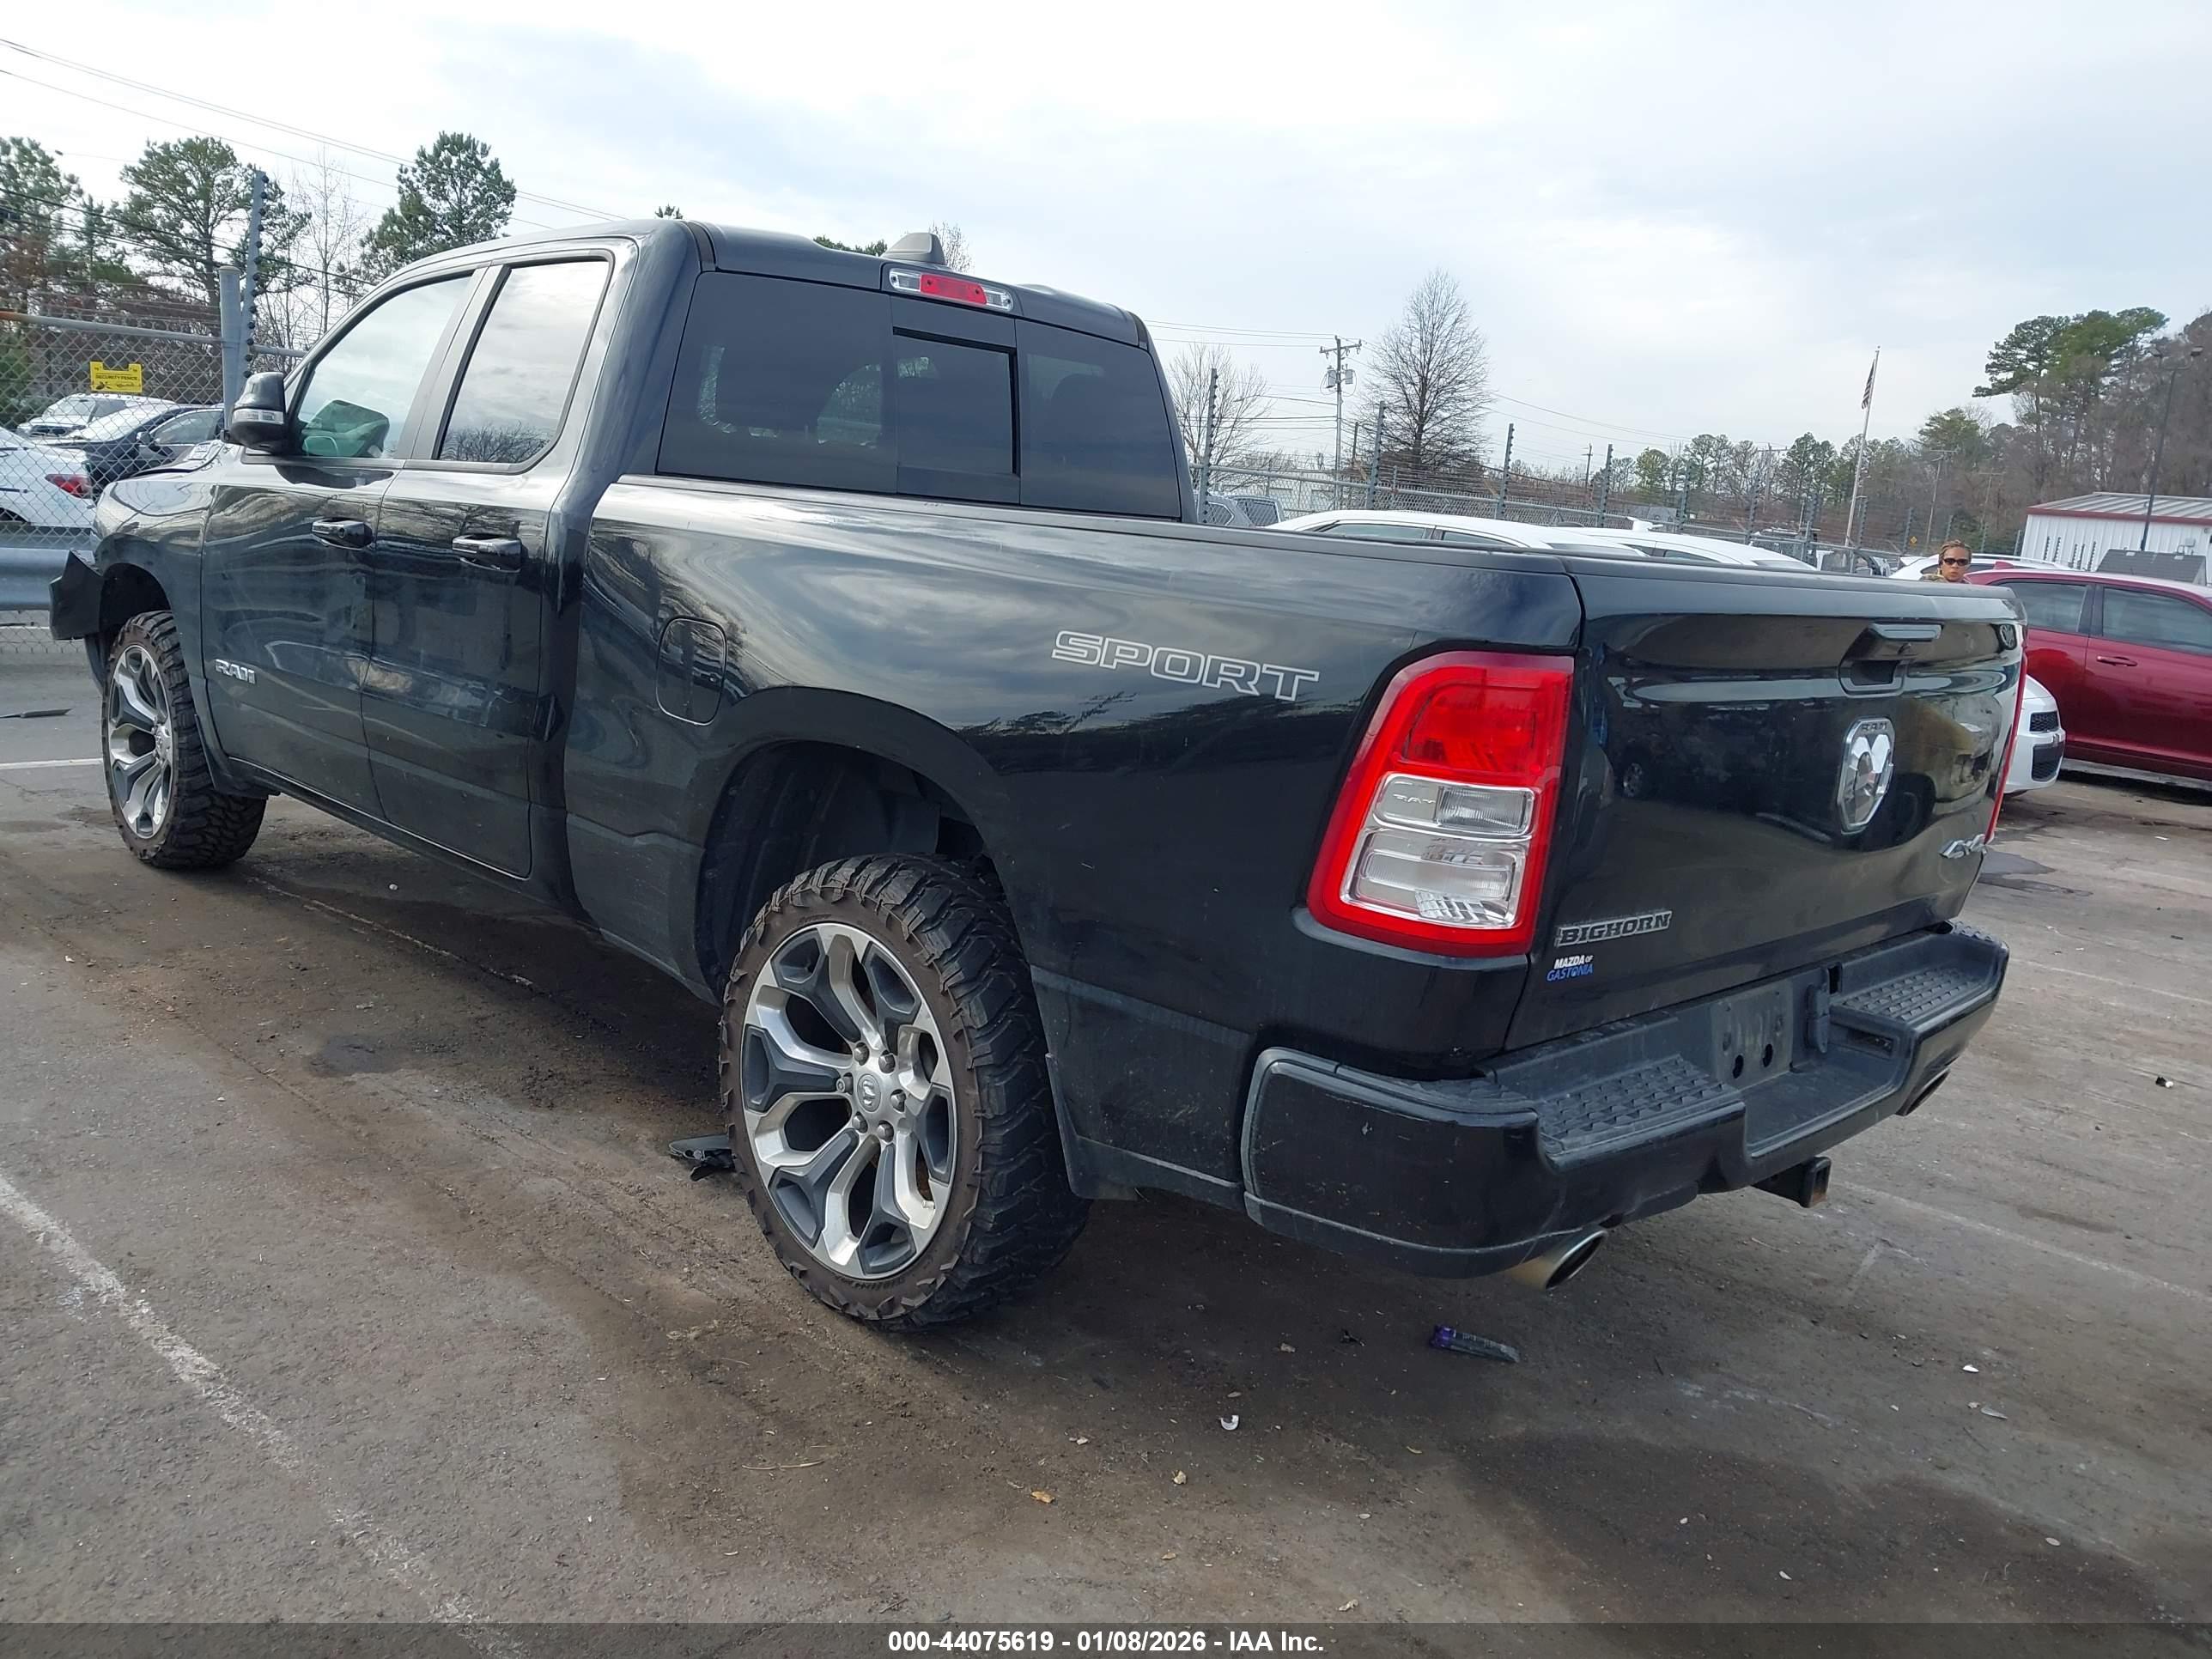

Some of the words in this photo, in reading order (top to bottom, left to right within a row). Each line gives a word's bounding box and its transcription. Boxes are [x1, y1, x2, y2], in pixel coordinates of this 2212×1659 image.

[216, 659, 256, 684] RAM
[1051, 630, 1320, 702] SPORT
[1554, 910, 1673, 947] BIGHORN
[1547, 963, 1594, 981] GASTONIA
[1554, 955, 1584, 969] MAZDA
